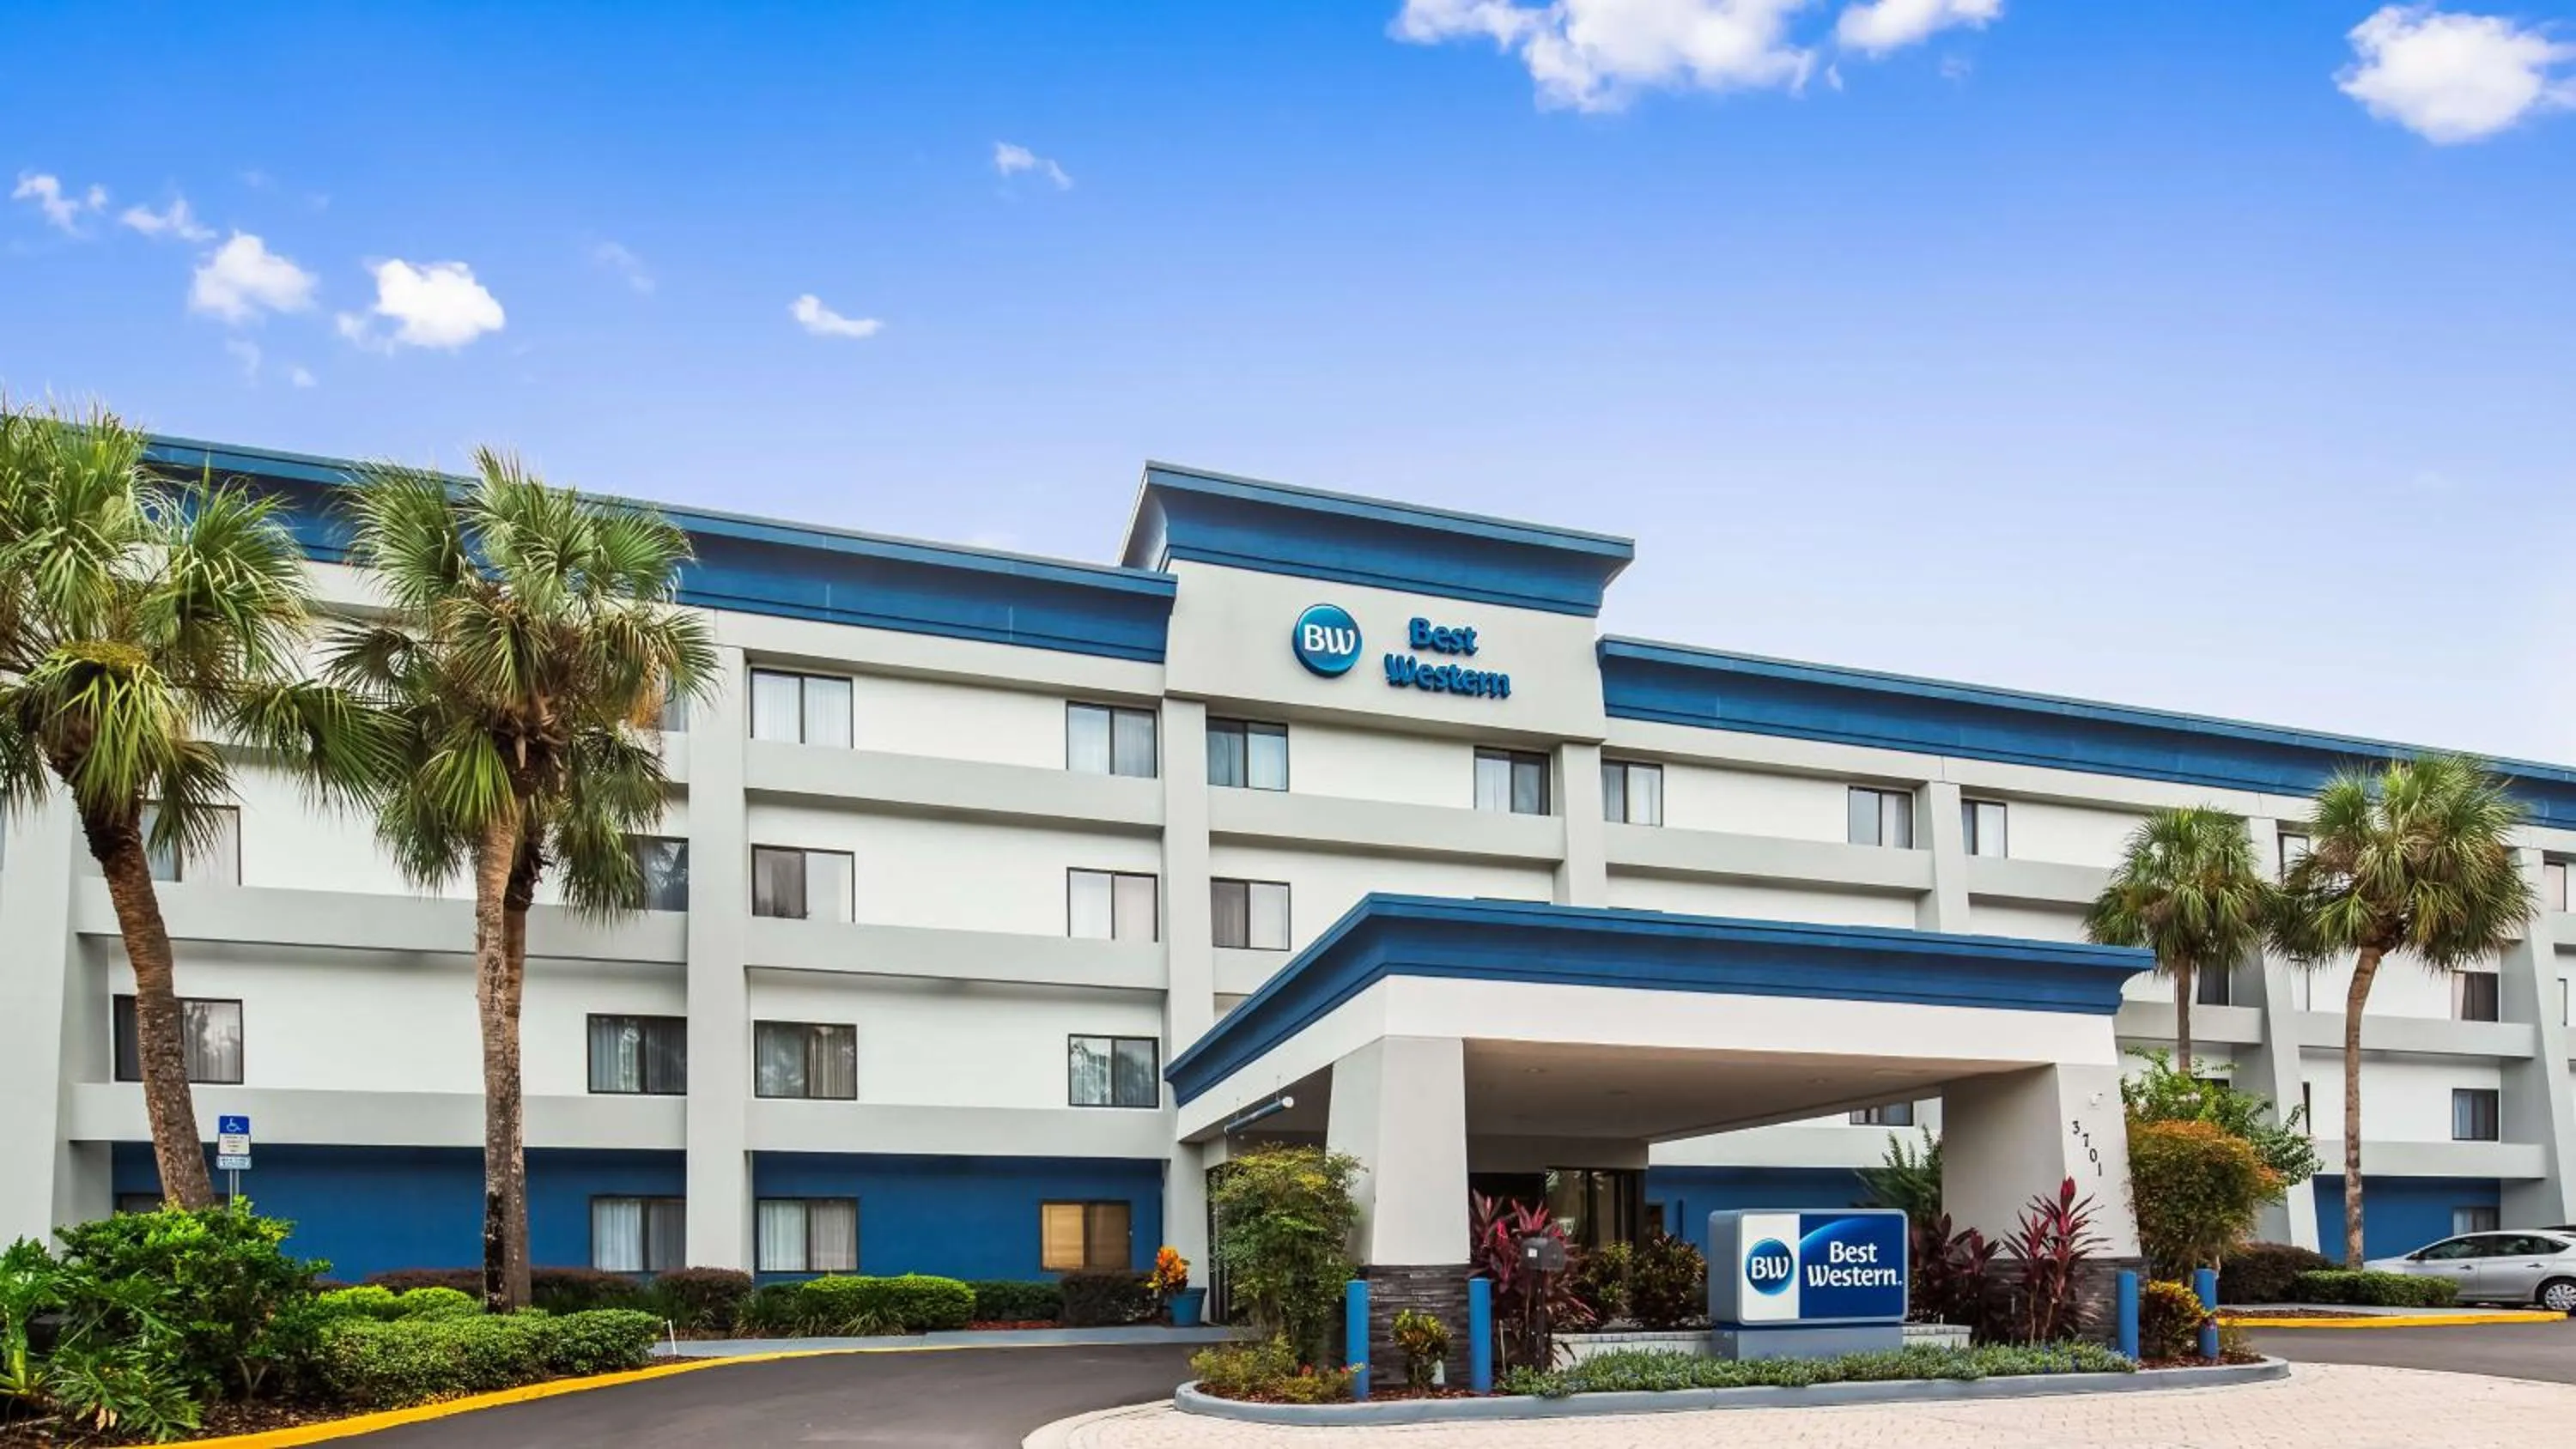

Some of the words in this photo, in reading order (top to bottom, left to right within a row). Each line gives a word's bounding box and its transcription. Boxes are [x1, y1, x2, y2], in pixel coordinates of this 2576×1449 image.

[1303, 624, 1356, 655] BW
[1409, 617, 1479, 656] Best
[1384, 653, 1511, 699] Western
[2072, 1120, 2103, 1177] 3701
[1751, 1256, 1790, 1280] BW
[1829, 1241, 1878, 1264] Best
